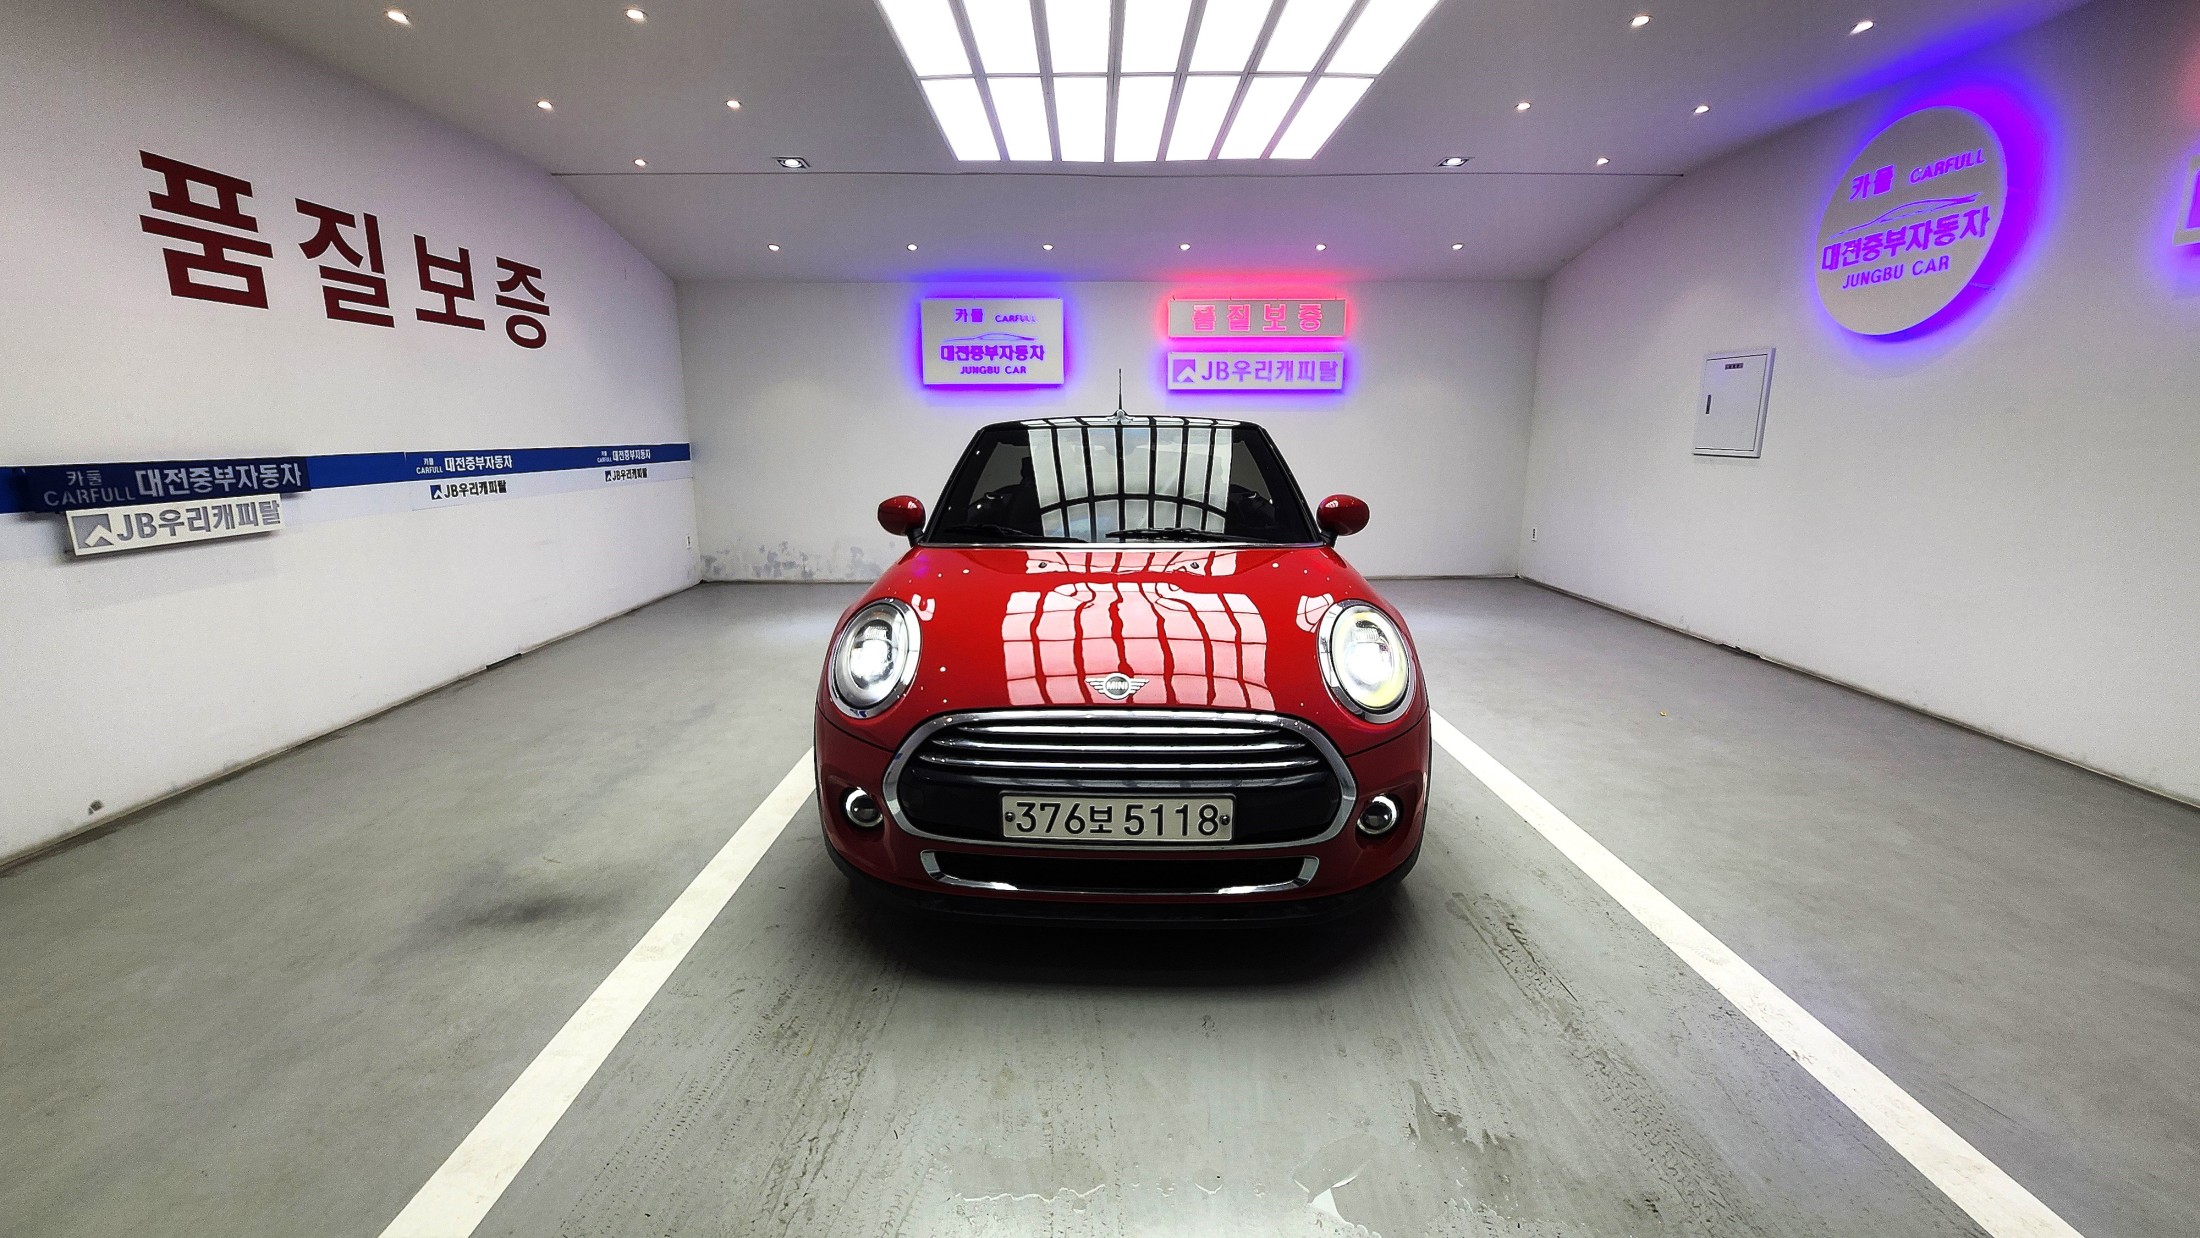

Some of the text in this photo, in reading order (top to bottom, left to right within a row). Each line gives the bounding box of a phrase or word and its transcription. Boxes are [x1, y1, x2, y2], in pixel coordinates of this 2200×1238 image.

[1909, 149, 1985, 184] CARFULL
[139, 149, 551, 350] 품질보증
[1821, 206, 1990, 270] 대전중부자동차
[1842, 255, 1949, 289] JUNGBU CAR
[1192, 304, 1323, 332] 품질보증
[940, 345, 1045, 361] 대전중부자동차
[960, 366, 1027, 374] JUNGBU CAR
[1201, 360, 1339, 382] JB우리캐피탈
[416, 466, 443, 474] CARFULL
[444, 455, 512, 472] 대전중부자동차
[134, 463, 302, 498] 대전중부자동차
[444, 480, 507, 498] JB우리캐피탈
[43, 486, 136, 507] CARFULL
[116, 500, 281, 541] JB우리캐피탈
[1106, 681, 1128, 690] MINI
[1016, 801, 1219, 836] 376보 5118
